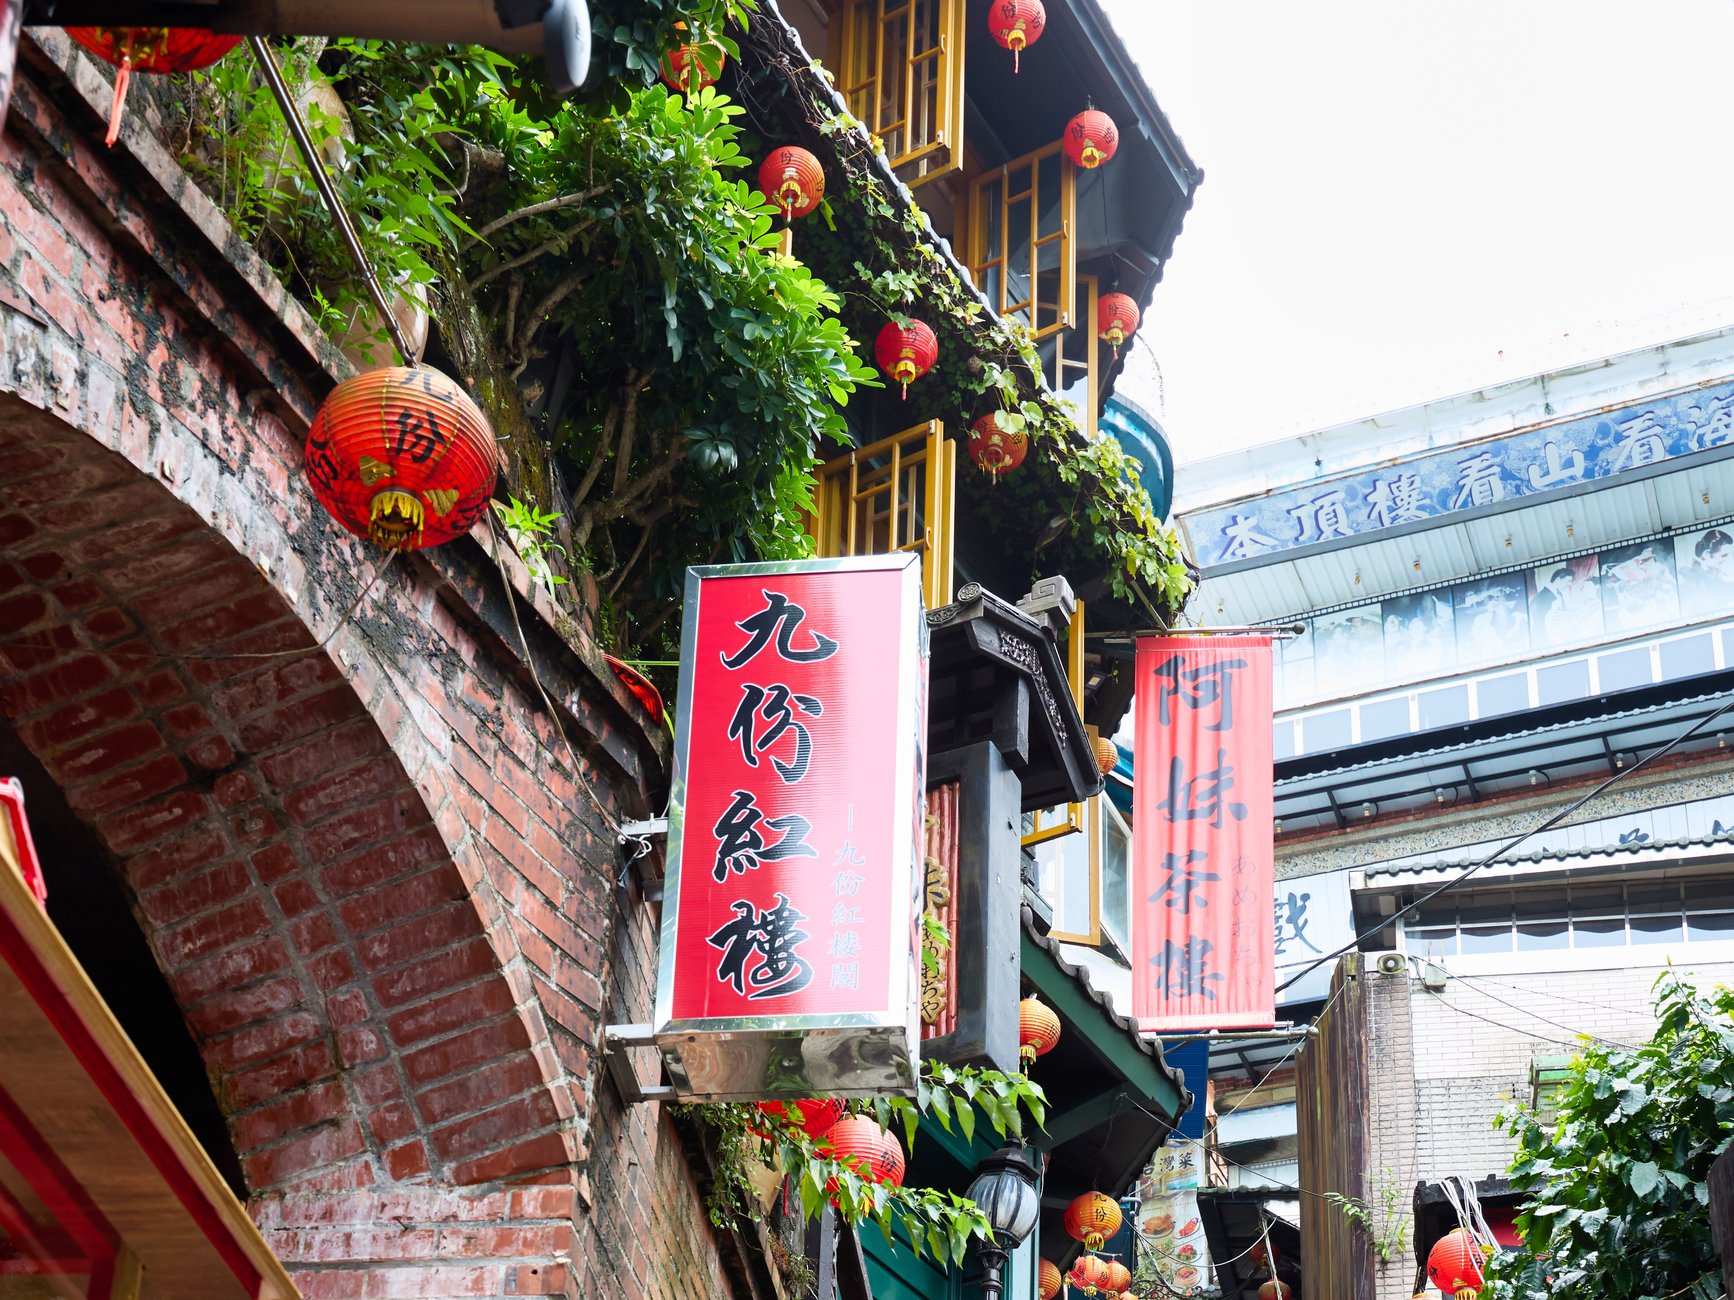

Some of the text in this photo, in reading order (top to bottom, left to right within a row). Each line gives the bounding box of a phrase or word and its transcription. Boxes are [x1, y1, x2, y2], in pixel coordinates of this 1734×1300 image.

[706, 589, 839, 1000] 九份紅樓
[1148, 655, 1248, 1001] 阿妹茶樓
[1094, 1194, 1107, 1222] 九份
